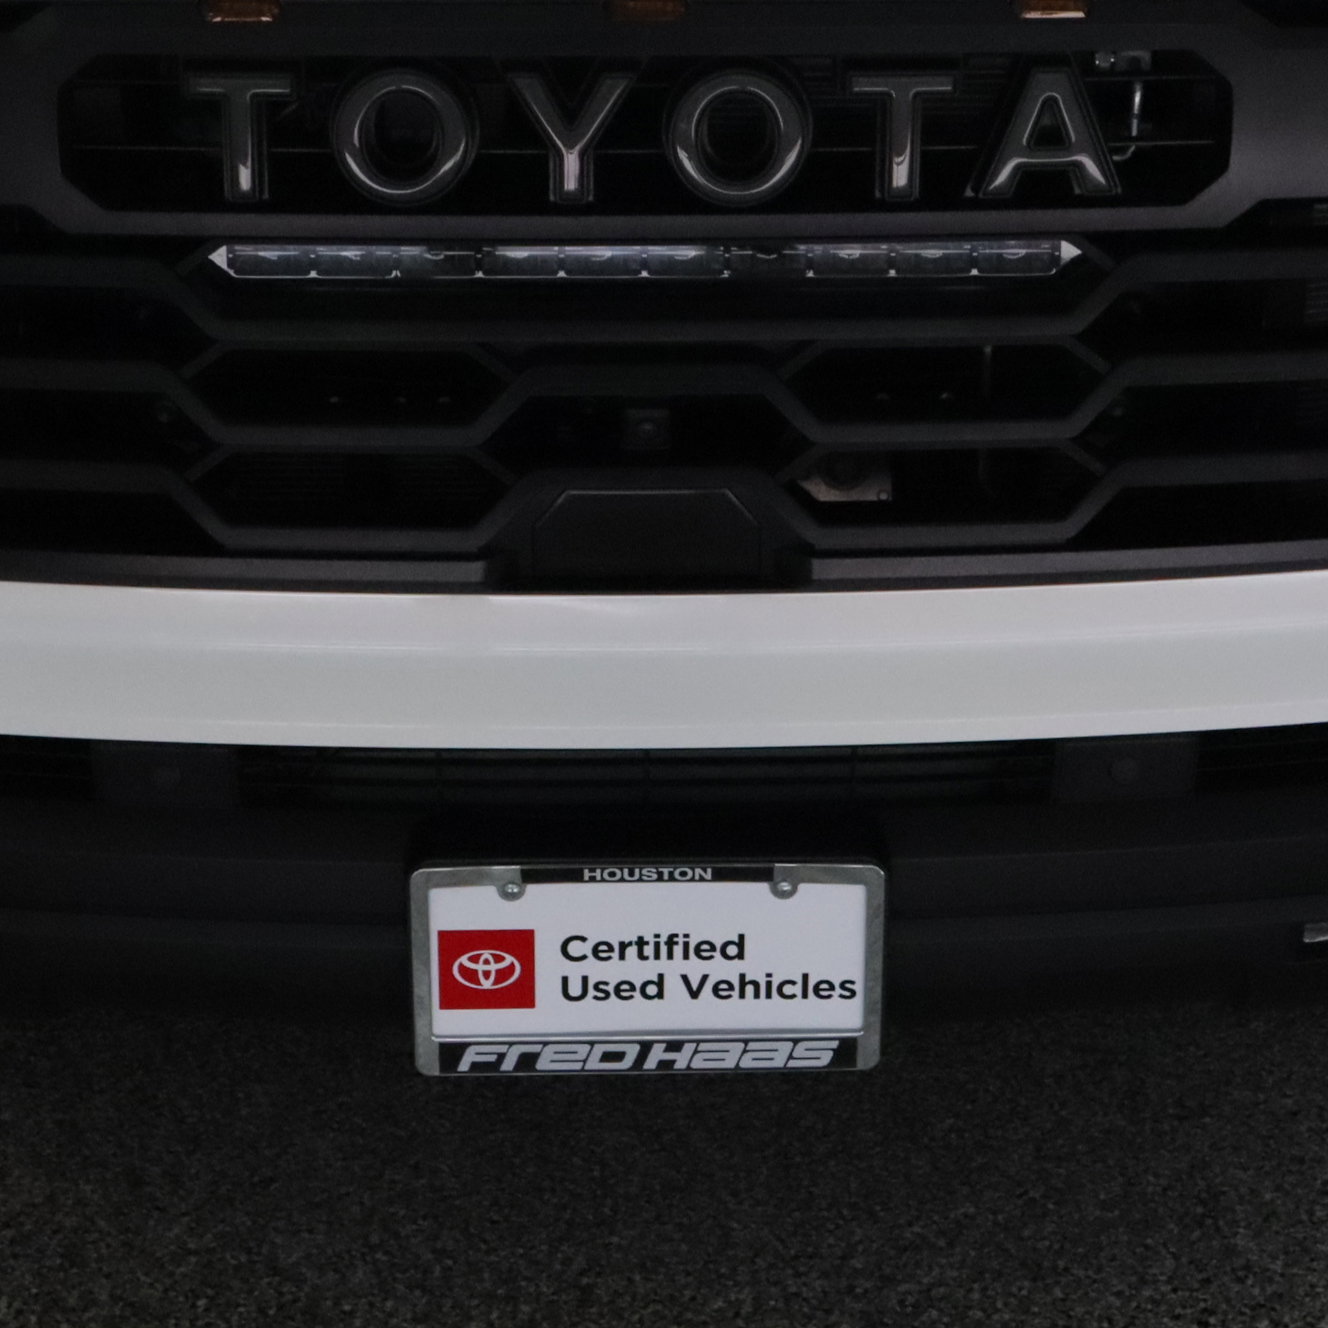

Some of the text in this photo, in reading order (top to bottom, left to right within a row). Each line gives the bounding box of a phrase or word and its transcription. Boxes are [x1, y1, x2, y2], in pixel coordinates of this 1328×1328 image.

[184, 63, 1124, 204] TOYOTA
[583, 867, 712, 882] HOUSTON
[560, 933, 747, 962] Certified
[560, 972, 858, 1002] Used Vehicles
